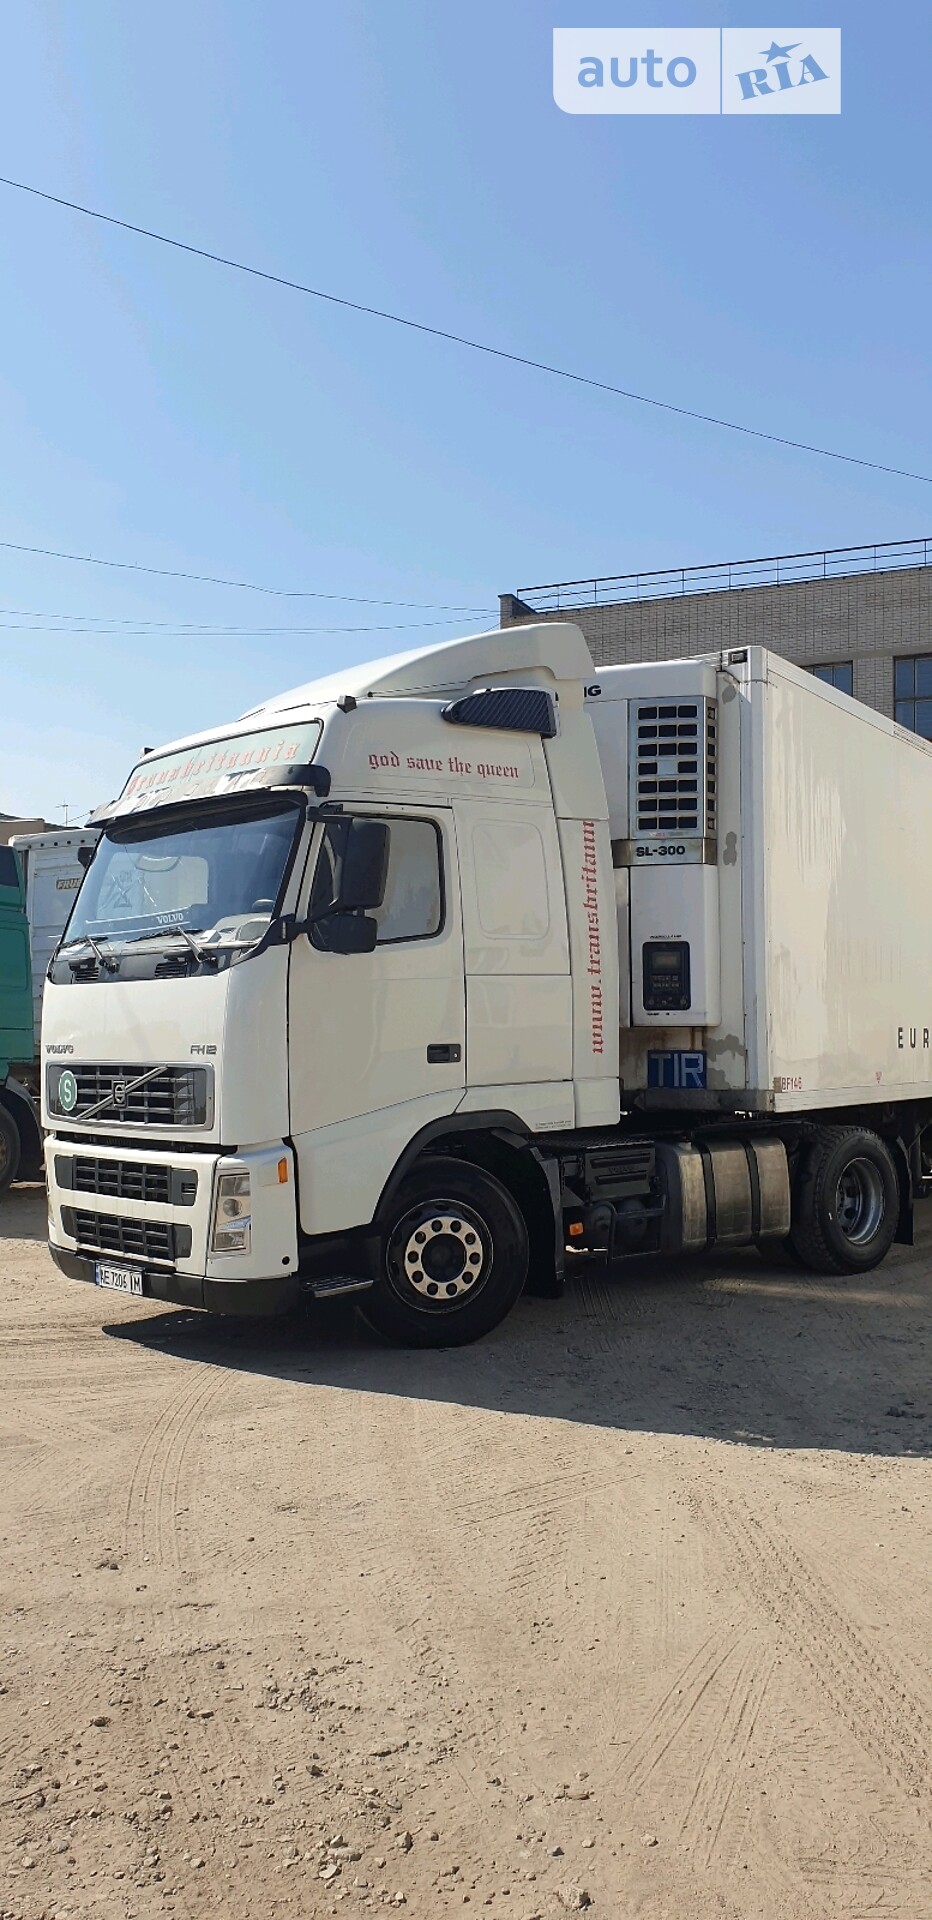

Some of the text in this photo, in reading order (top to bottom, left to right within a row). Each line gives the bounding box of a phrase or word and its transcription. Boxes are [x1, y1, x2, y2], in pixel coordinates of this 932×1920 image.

[368, 751, 519, 778] god save the queen
[636, 845, 686, 857] SL-300
[156, 912, 184, 924] VOLVO
[45, 1044, 74, 1054] VOLVO
[190, 1044, 217, 1055] FH12
[650, 1053, 704, 1087] TIR
[64, 1080, 71, 1102] S
